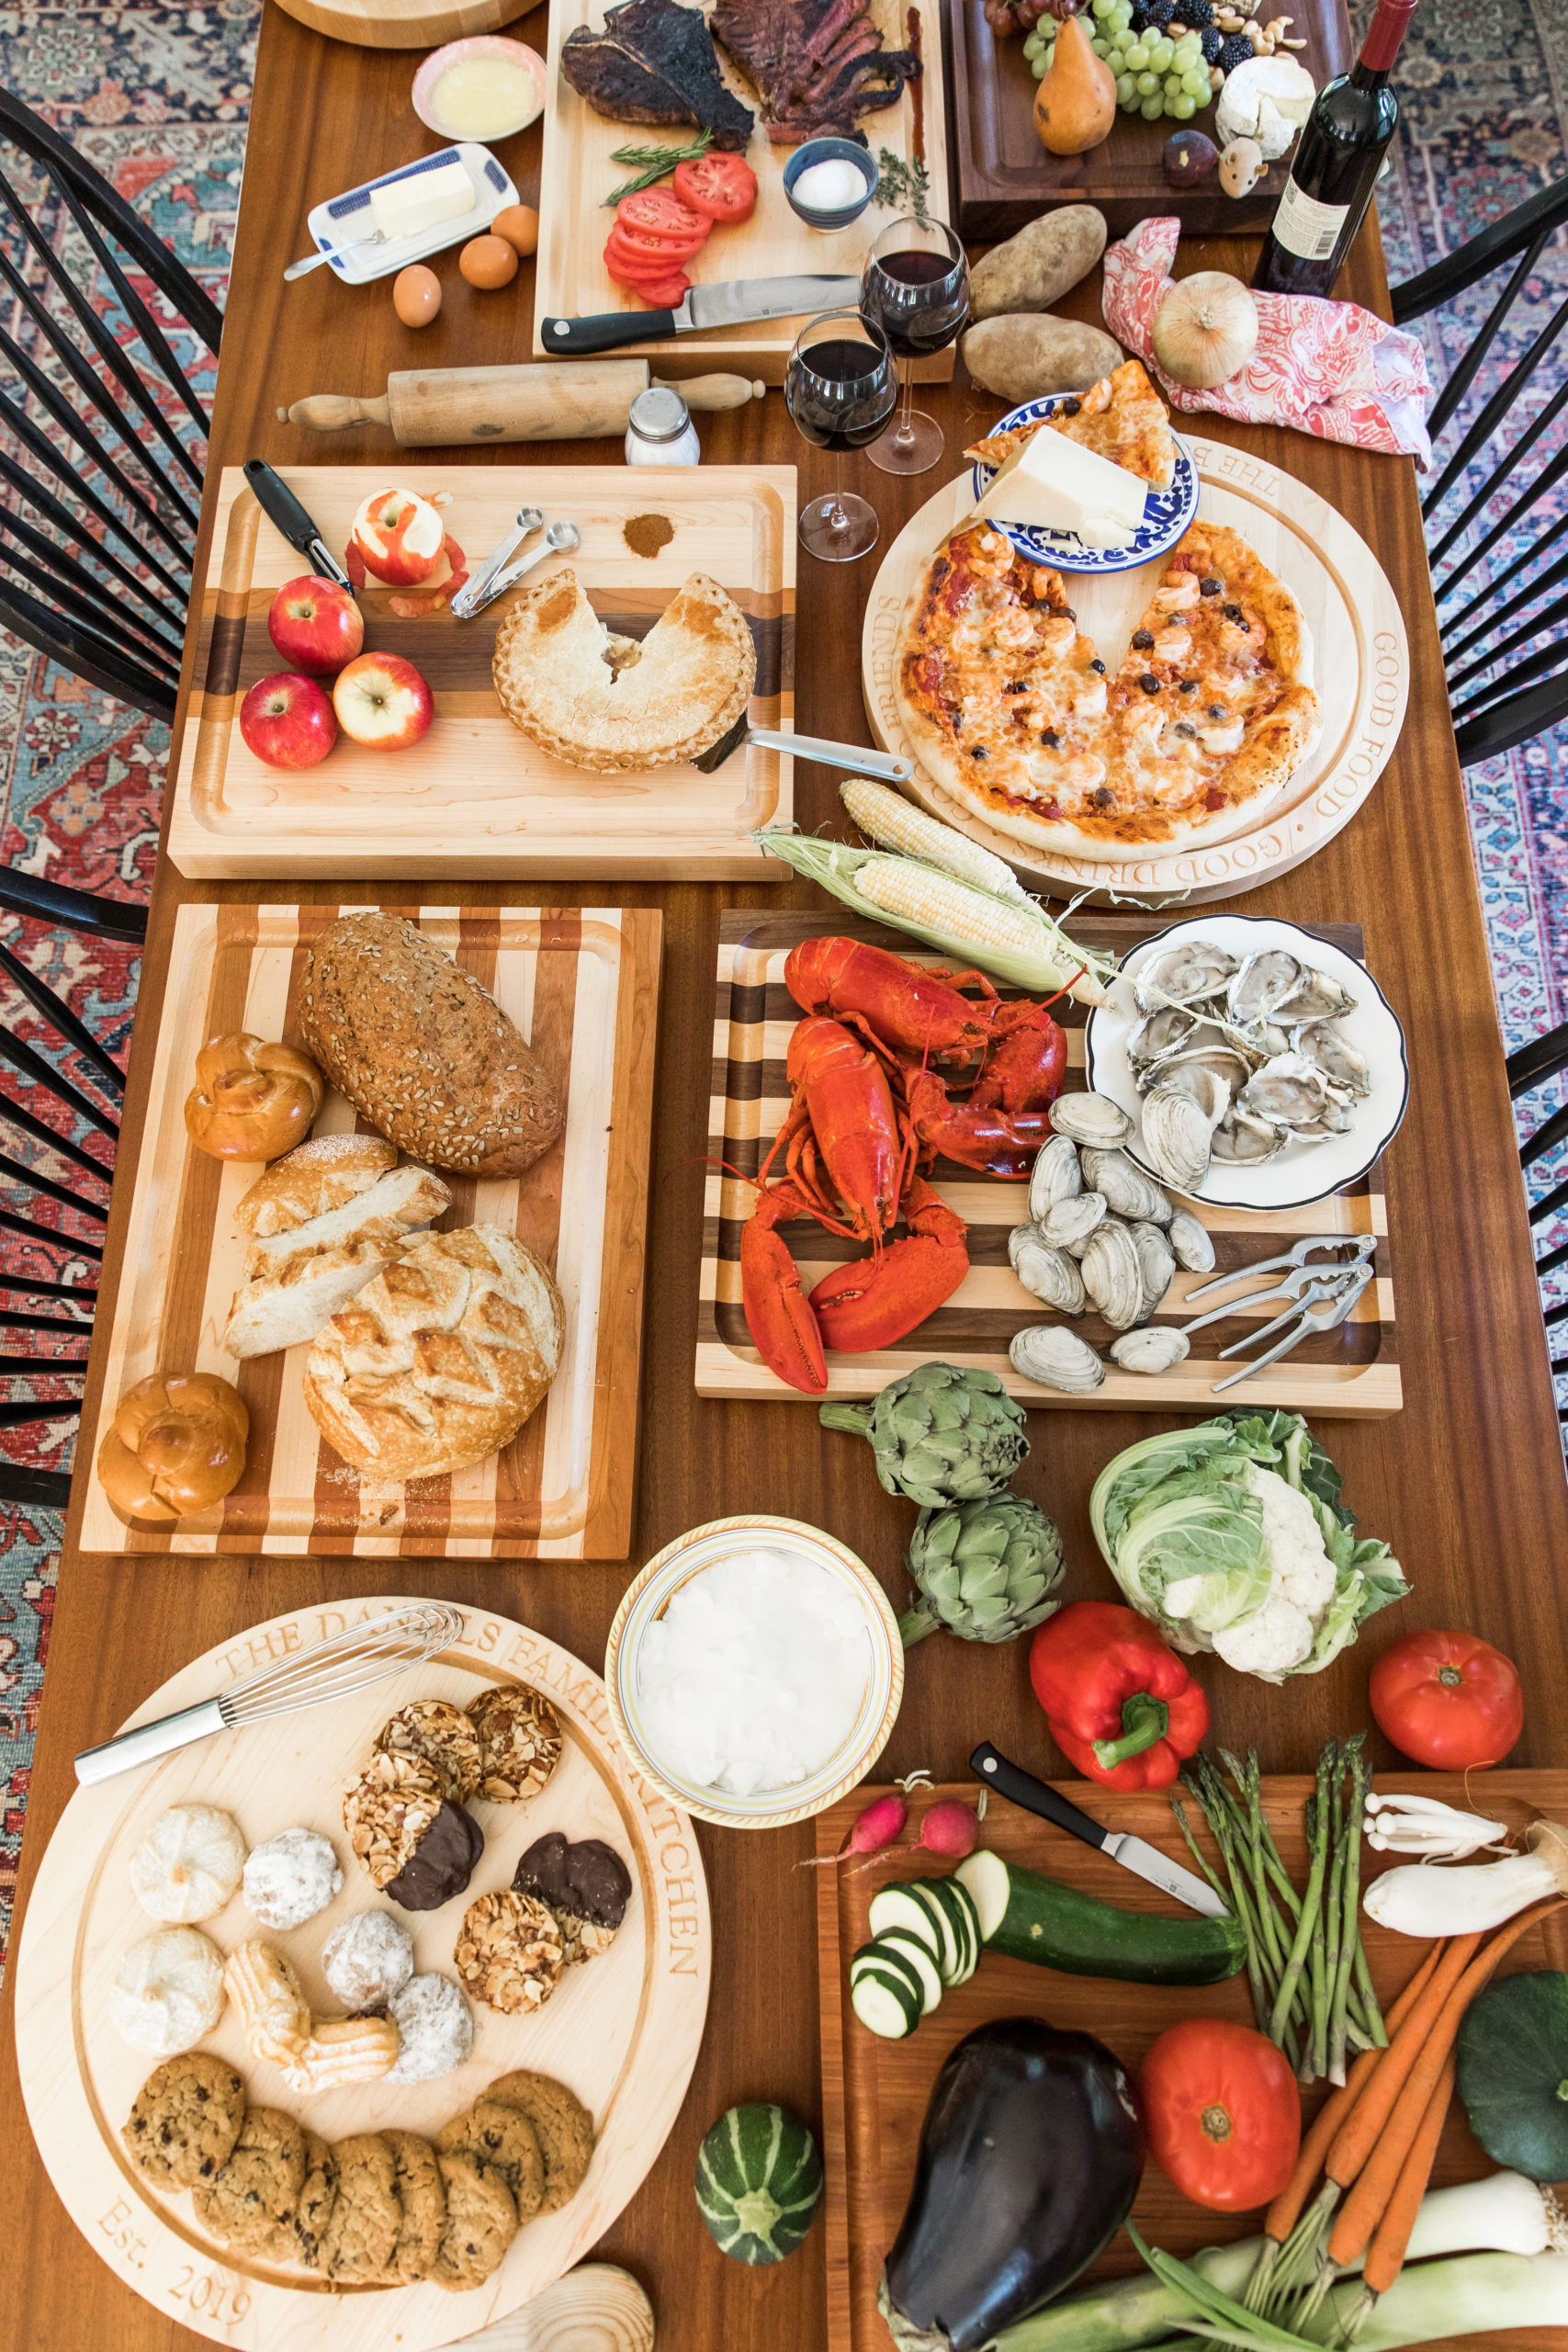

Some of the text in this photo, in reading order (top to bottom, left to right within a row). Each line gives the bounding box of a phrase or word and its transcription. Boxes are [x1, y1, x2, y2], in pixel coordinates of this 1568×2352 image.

[1218, 455, 1280, 497] THE
[872, 594, 902, 732] FRIENDS
[1315, 631, 1400, 818] GOOD FOOD
[1012, 833, 1283, 886] GOOD DRINKS
[215, 1621, 304, 1679] THE
[507, 1634, 621, 1755] FAMIL
[97, 2195, 252, 2326] Est. 2019
